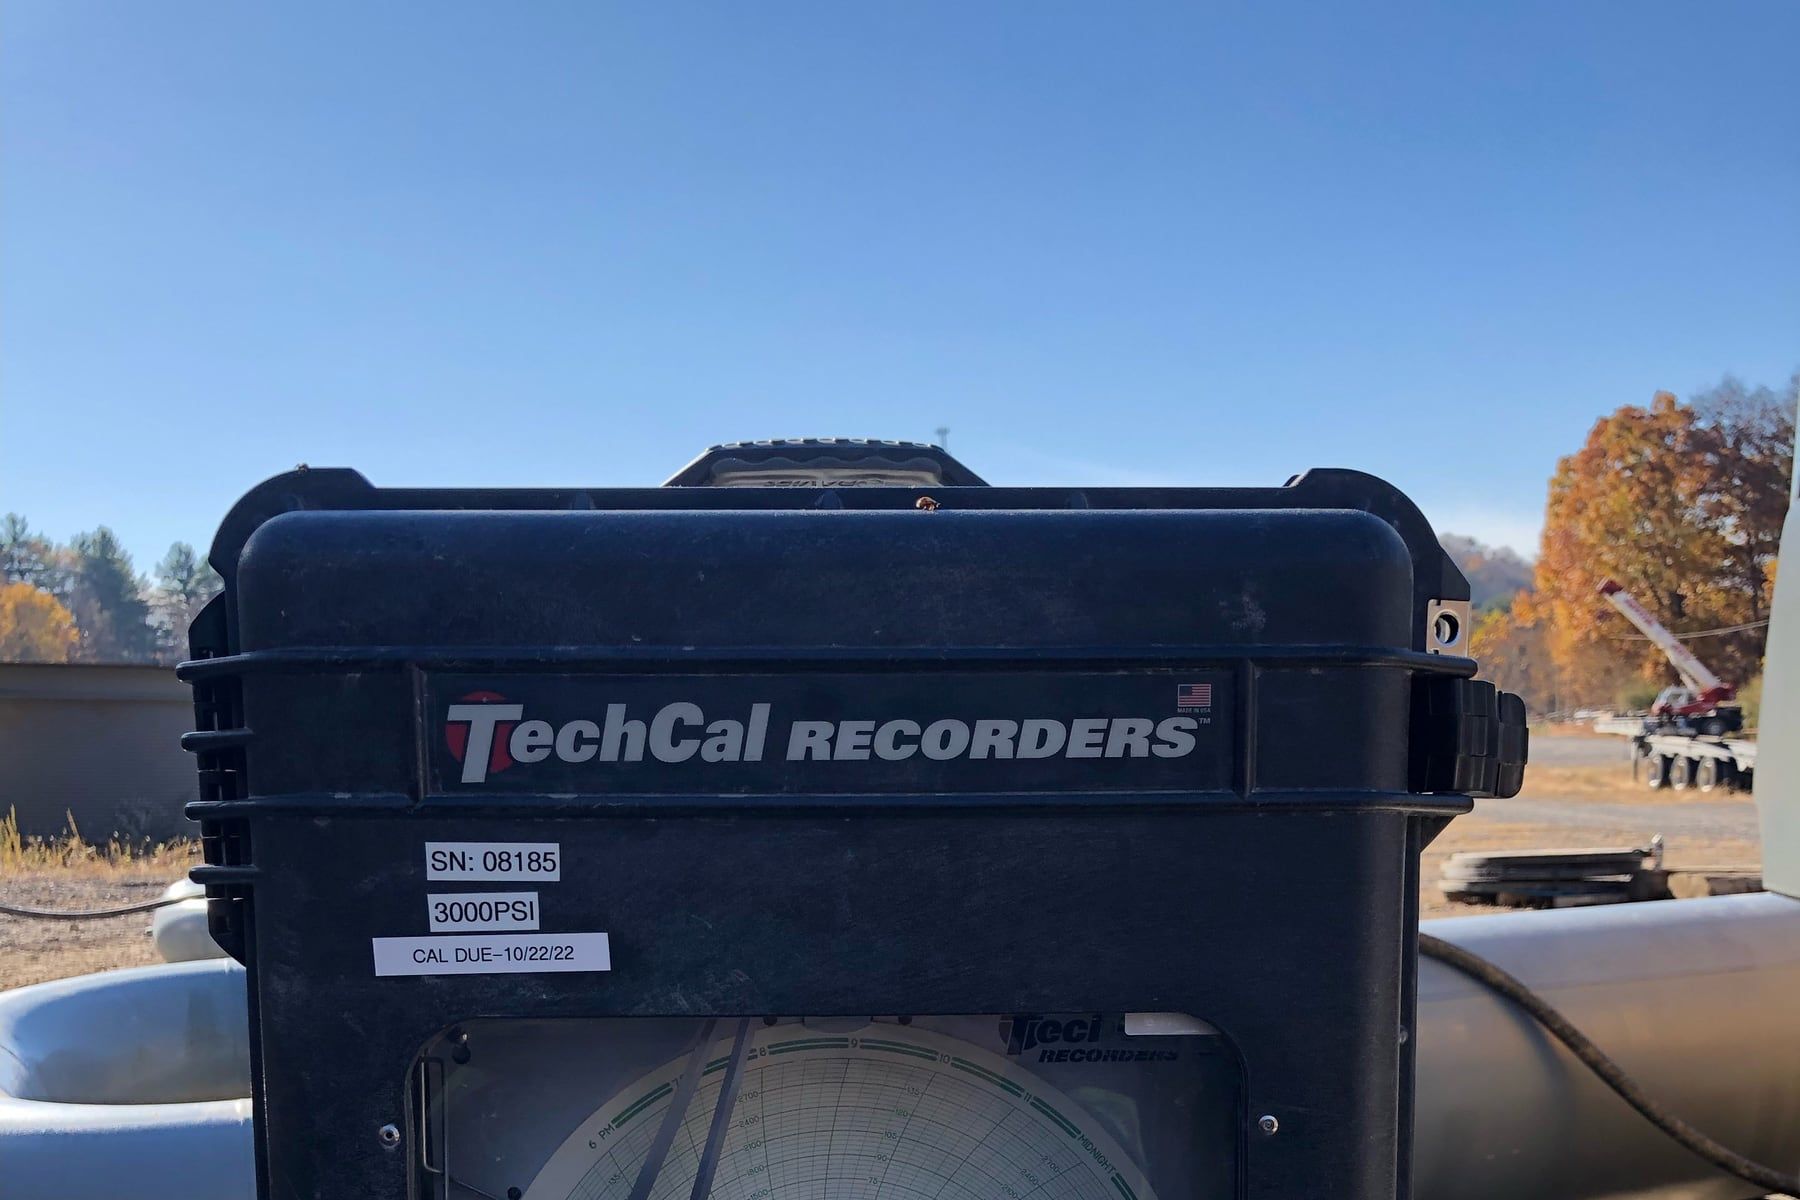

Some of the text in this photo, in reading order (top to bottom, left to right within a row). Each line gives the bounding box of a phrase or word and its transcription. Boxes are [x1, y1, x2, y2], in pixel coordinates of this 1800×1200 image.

[446, 702, 1198, 784] TechCal RECORDERS
[431, 850, 557, 873] SN: 08185
[434, 900, 535, 923] 3000PSI
[413, 945, 575, 964] CAL DUE-10/22/22
[850, 1039, 858, 1049] 9
[759, 1046, 768, 1057] 8
[939, 1053, 951, 1064] 10
[737, 1090, 759, 1103] 2700
[1023, 1092, 1032, 1103] 11
[739, 1115, 760, 1128] 2400
[588, 1123, 616, 1150] 6 PM
[743, 1140, 761, 1152] 2100
[1079, 1132, 1117, 1174] MIDNIGHT
[747, 1164, 765, 1176] 1800
[750, 1188, 769, 1200] 1500
